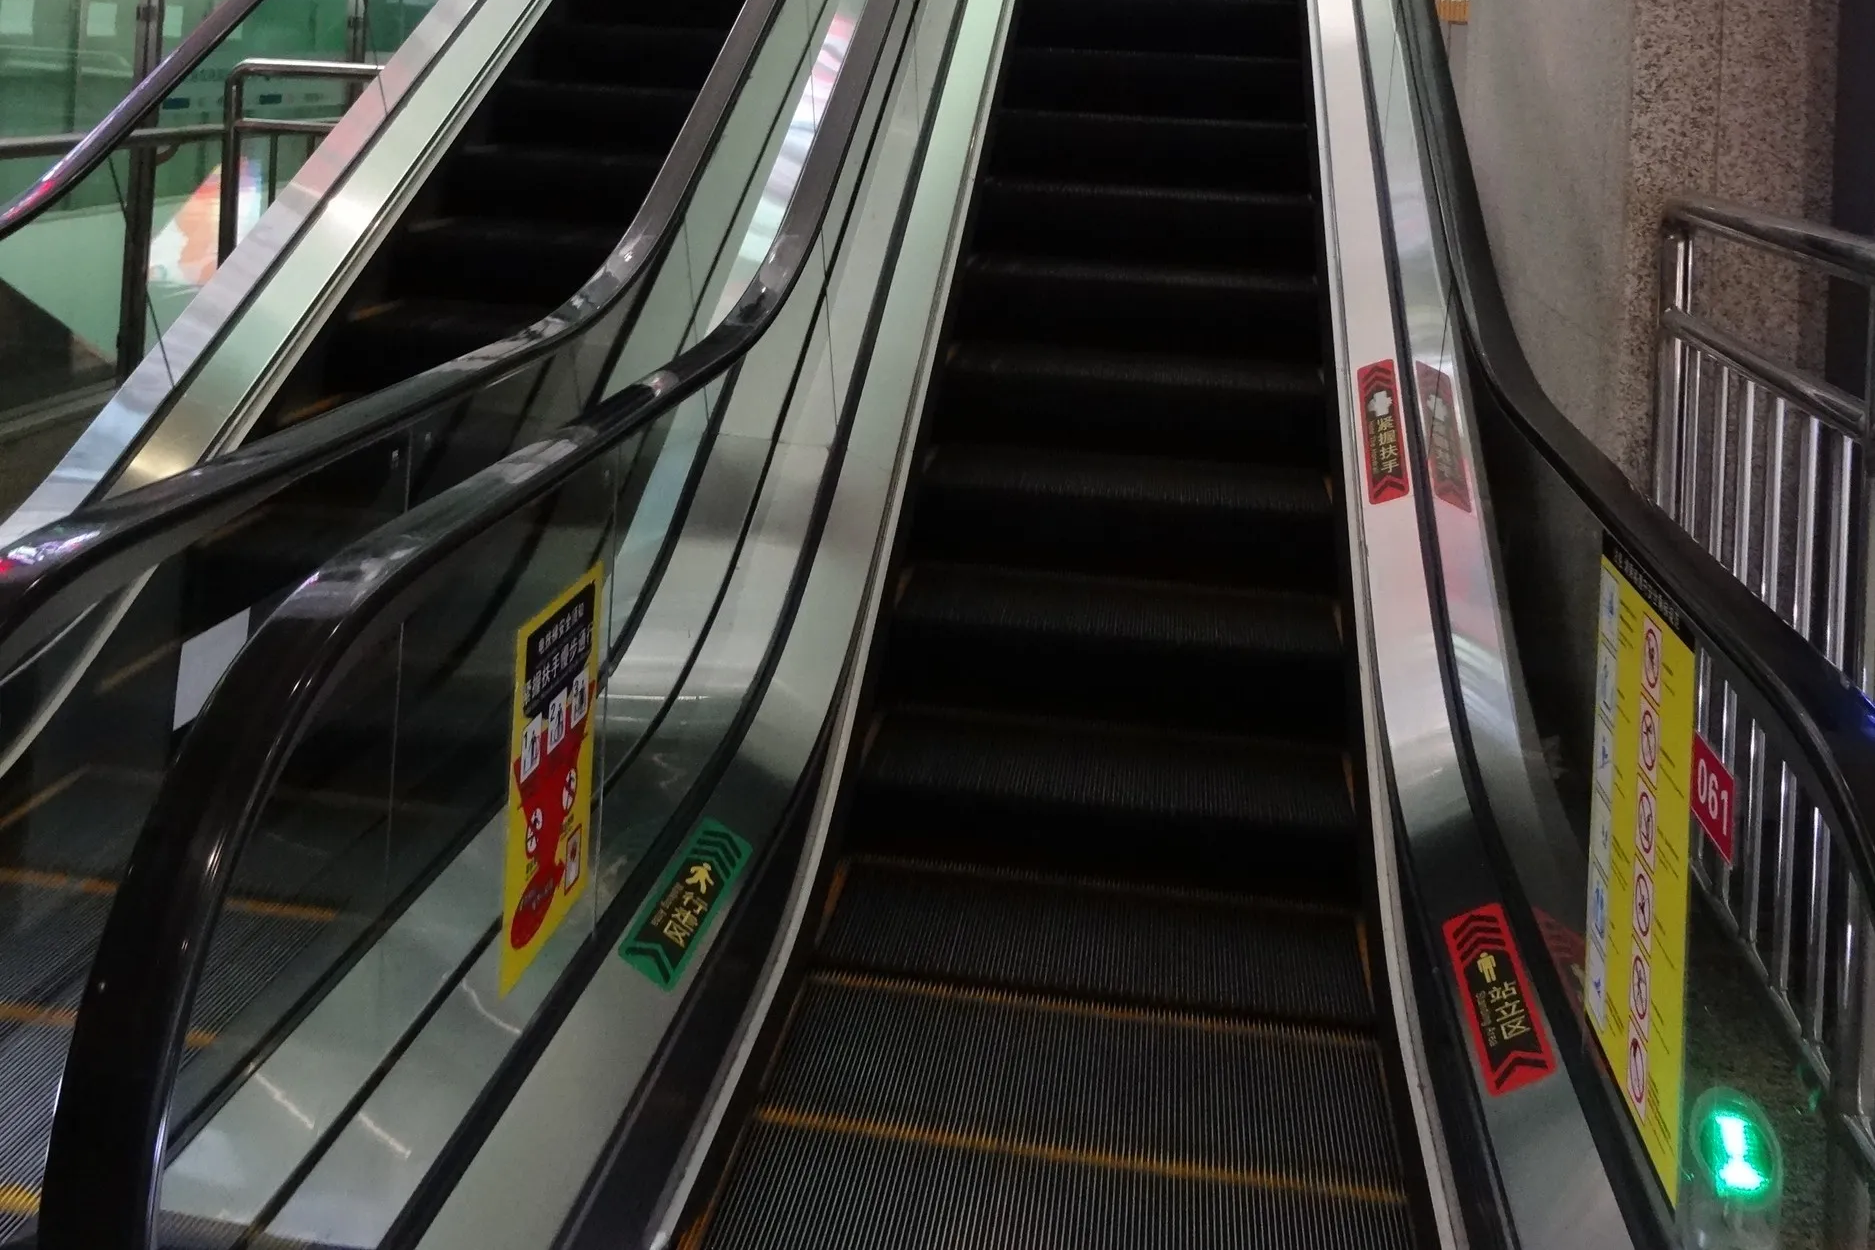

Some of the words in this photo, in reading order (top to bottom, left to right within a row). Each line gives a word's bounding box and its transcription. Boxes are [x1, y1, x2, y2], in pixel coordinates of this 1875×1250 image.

[1376, 415, 1400, 474] 紧握扶手
[1697, 757, 1729, 837] 061
[1487, 980, 1532, 1041] 站立区
